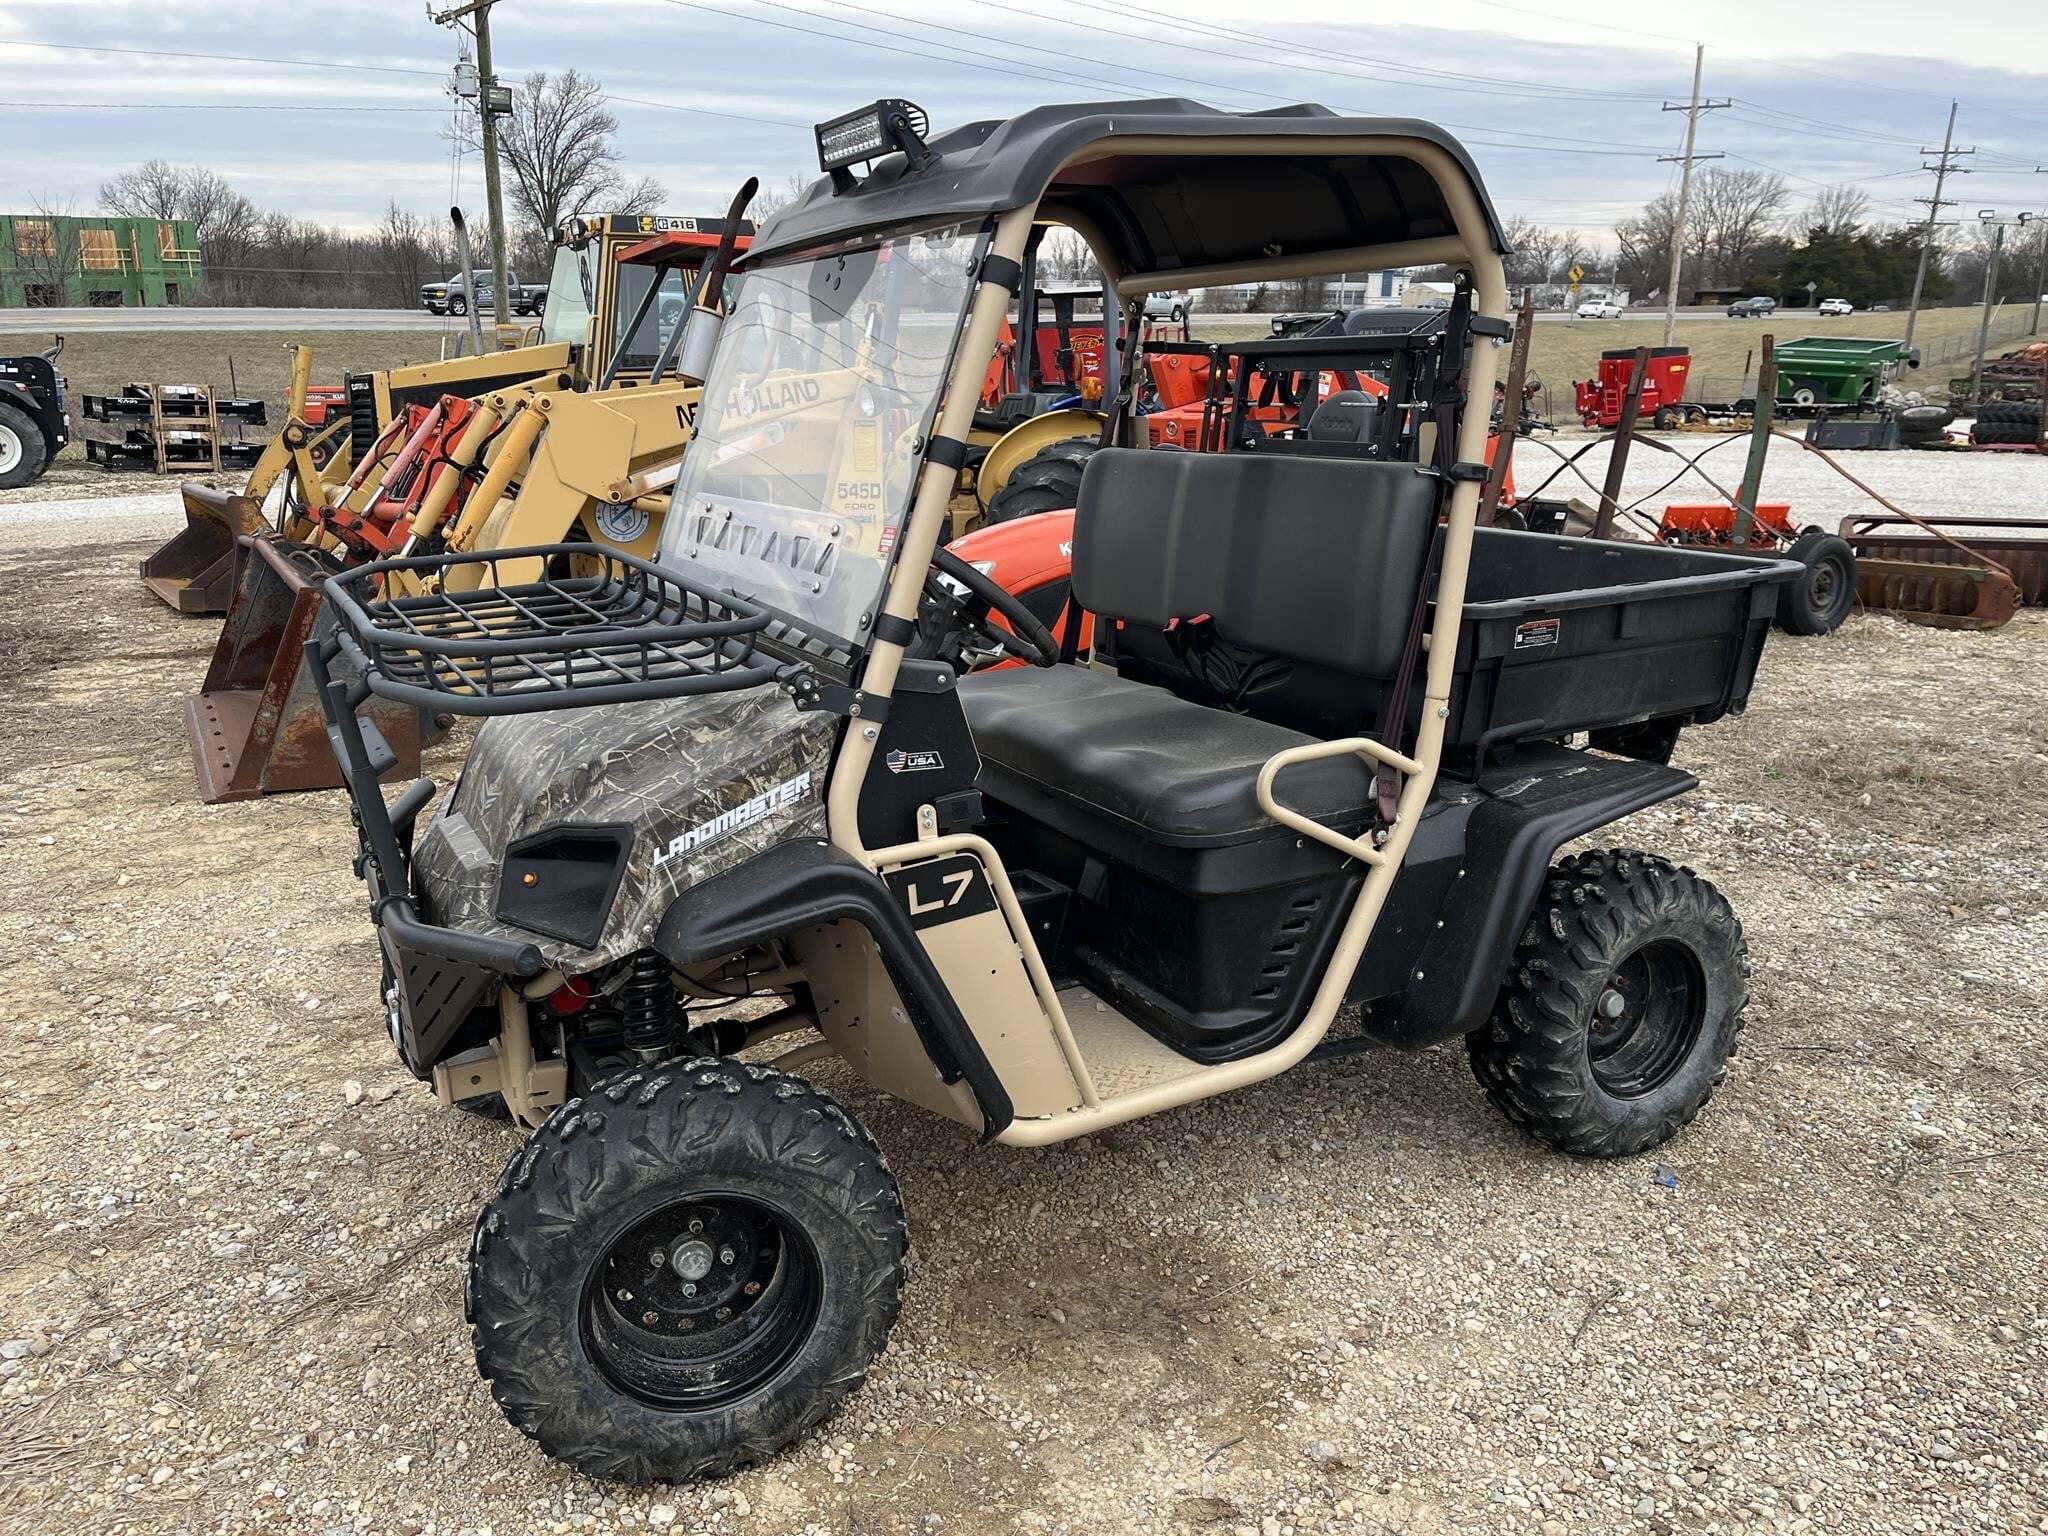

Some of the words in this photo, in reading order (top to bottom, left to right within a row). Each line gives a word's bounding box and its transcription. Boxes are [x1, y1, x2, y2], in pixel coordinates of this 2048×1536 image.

[670, 220, 695, 230] 416
[676, 401, 699, 430] NE
[837, 482, 881, 500] 545D
[844, 502, 876, 511] FORD
[907, 756, 937, 767] USA
[653, 770, 811, 867] LANDMASTER
[907, 868, 974, 916] L7
